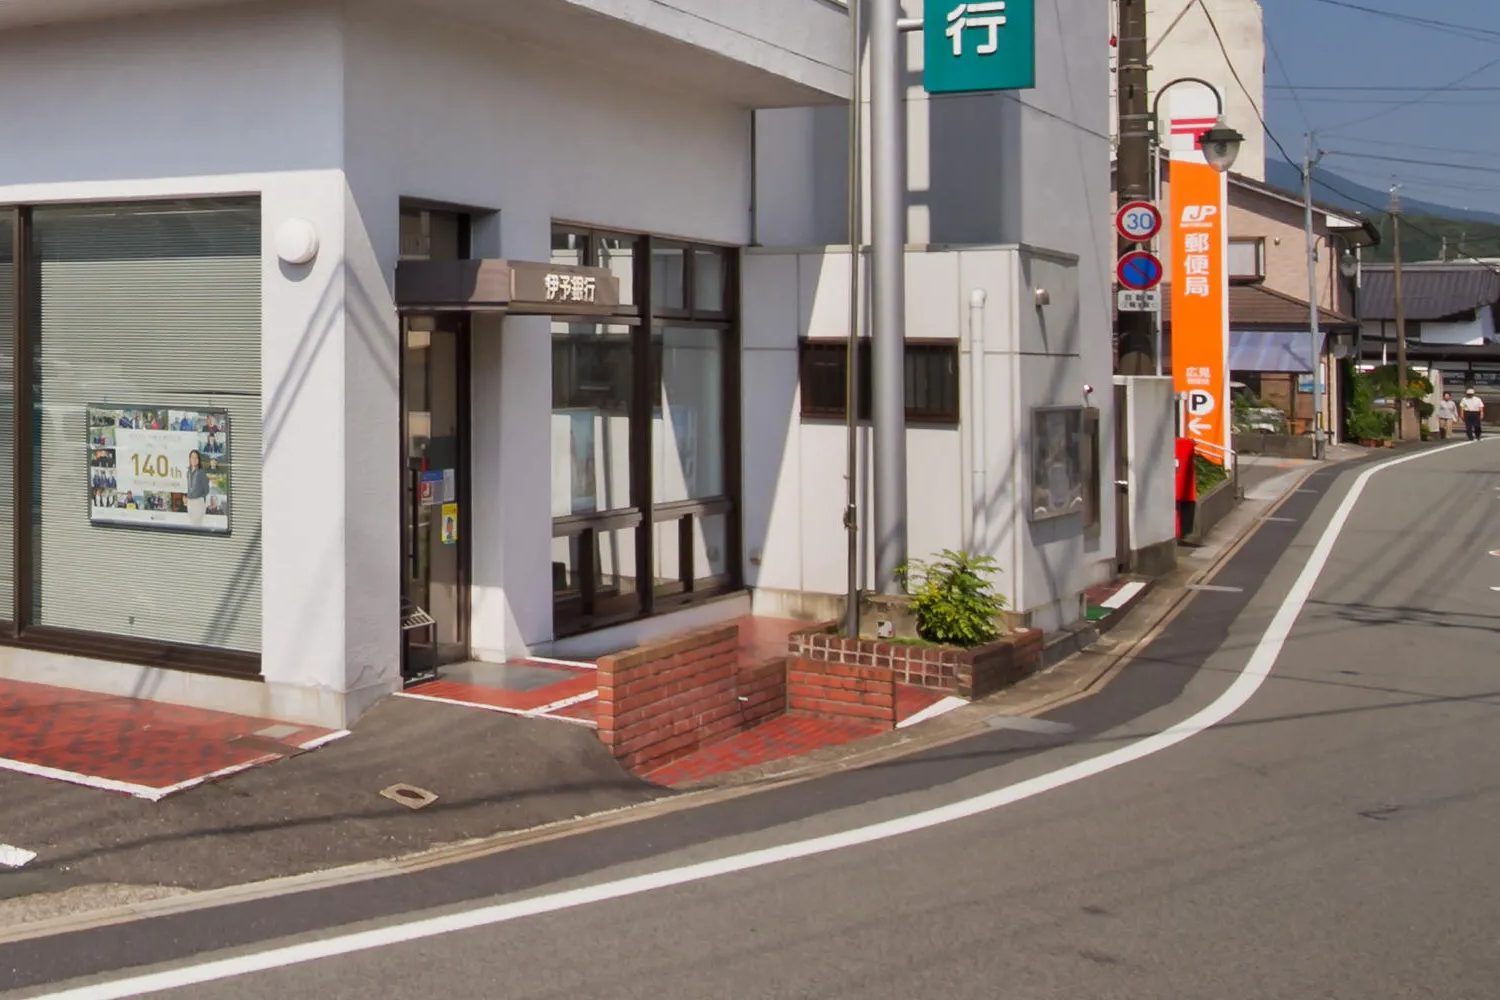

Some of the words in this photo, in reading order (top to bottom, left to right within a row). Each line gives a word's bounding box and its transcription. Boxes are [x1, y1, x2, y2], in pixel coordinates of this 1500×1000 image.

[1127, 213, 1155, 230] 30
[1183, 232, 1210, 297] 郵便局
[545, 274, 596, 302] 伊予銀行
[1192, 394, 1208, 411] P
